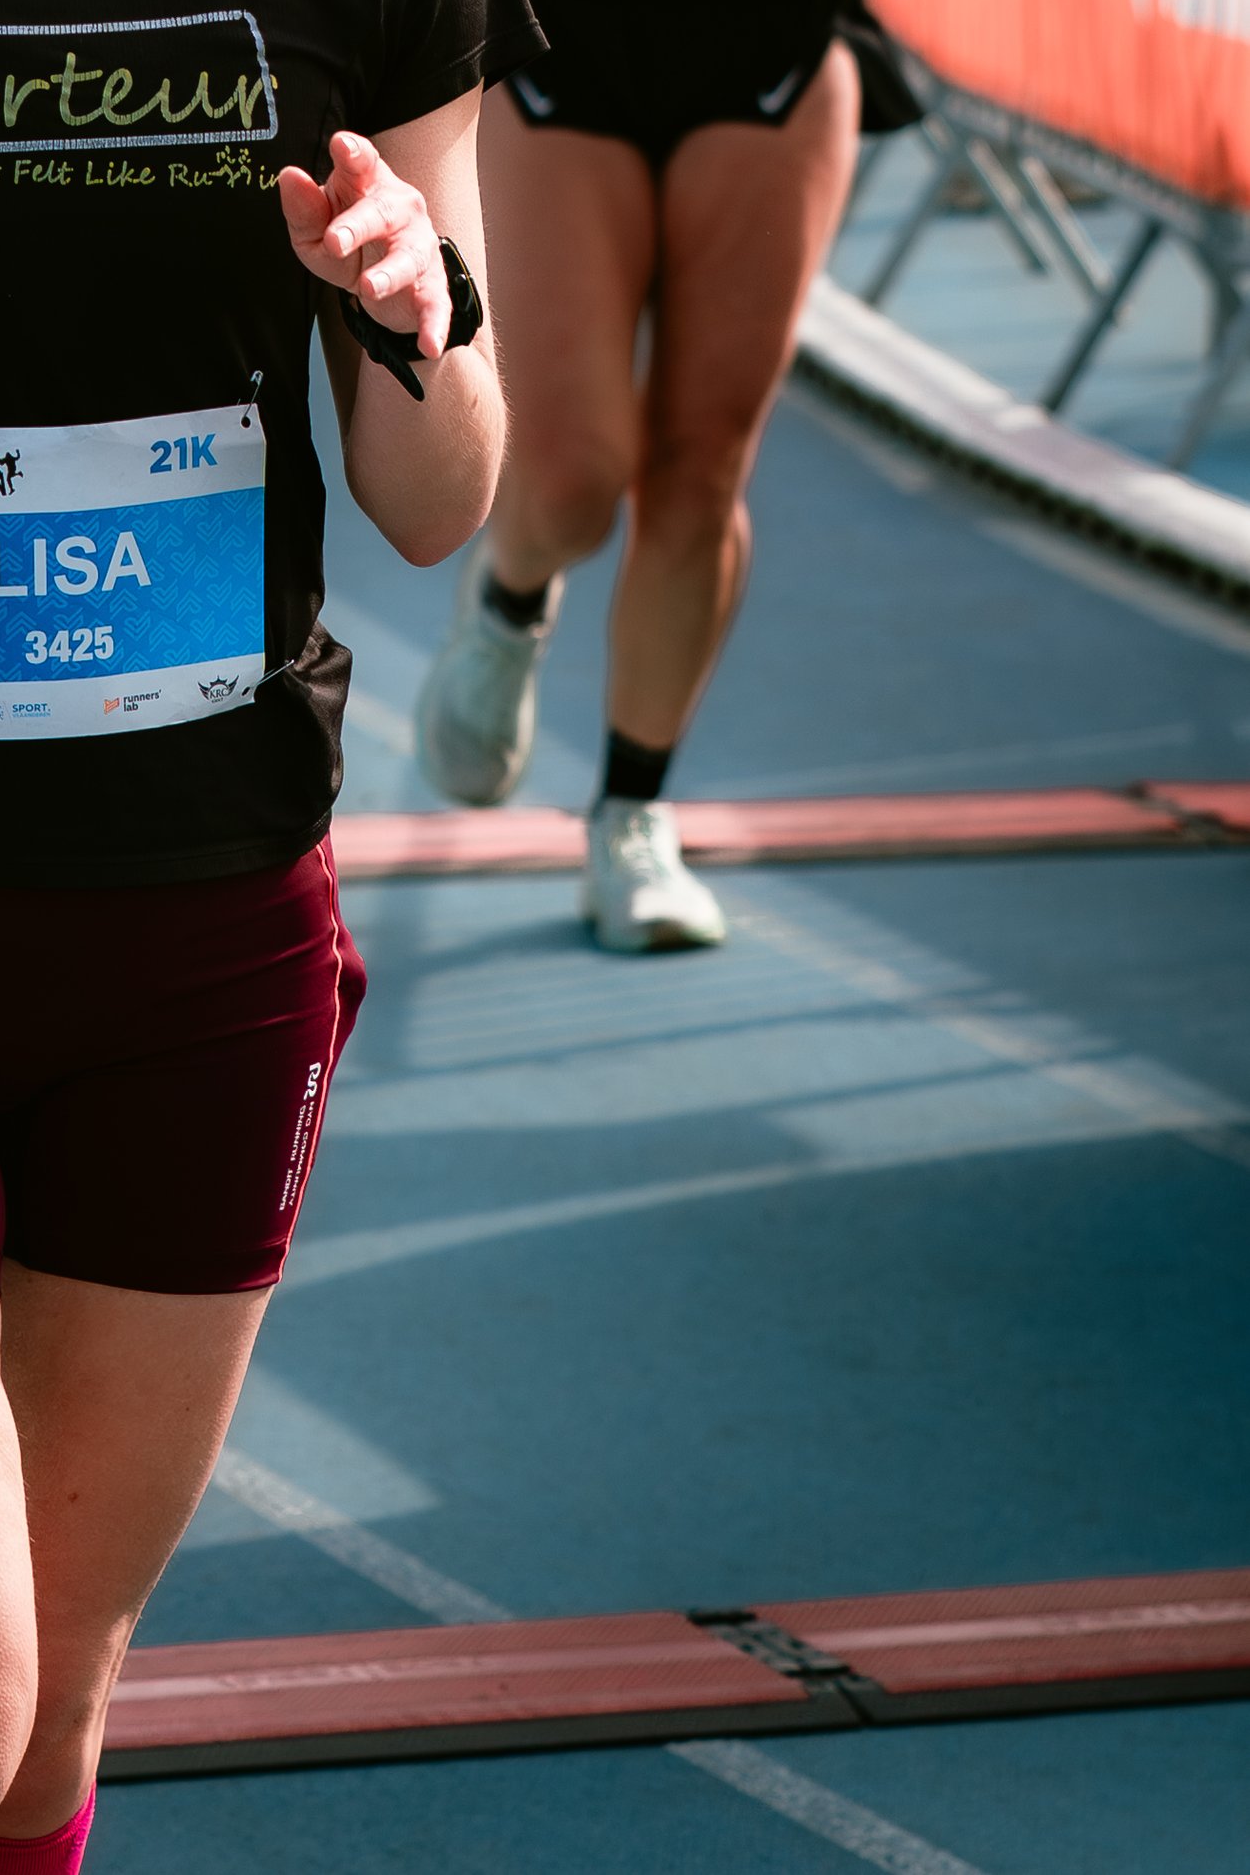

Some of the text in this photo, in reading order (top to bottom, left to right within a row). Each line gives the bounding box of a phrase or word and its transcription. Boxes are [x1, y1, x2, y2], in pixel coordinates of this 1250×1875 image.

[14, 159, 74, 185] Felt
[85, 160, 155, 187] Like
[149, 433, 218, 474] 21K
[25, 625, 115, 665] 3425
[123, 689, 162, 704] runners'
[123, 702, 139, 713] lab
[290, 1104, 307, 1162] RUNNING
